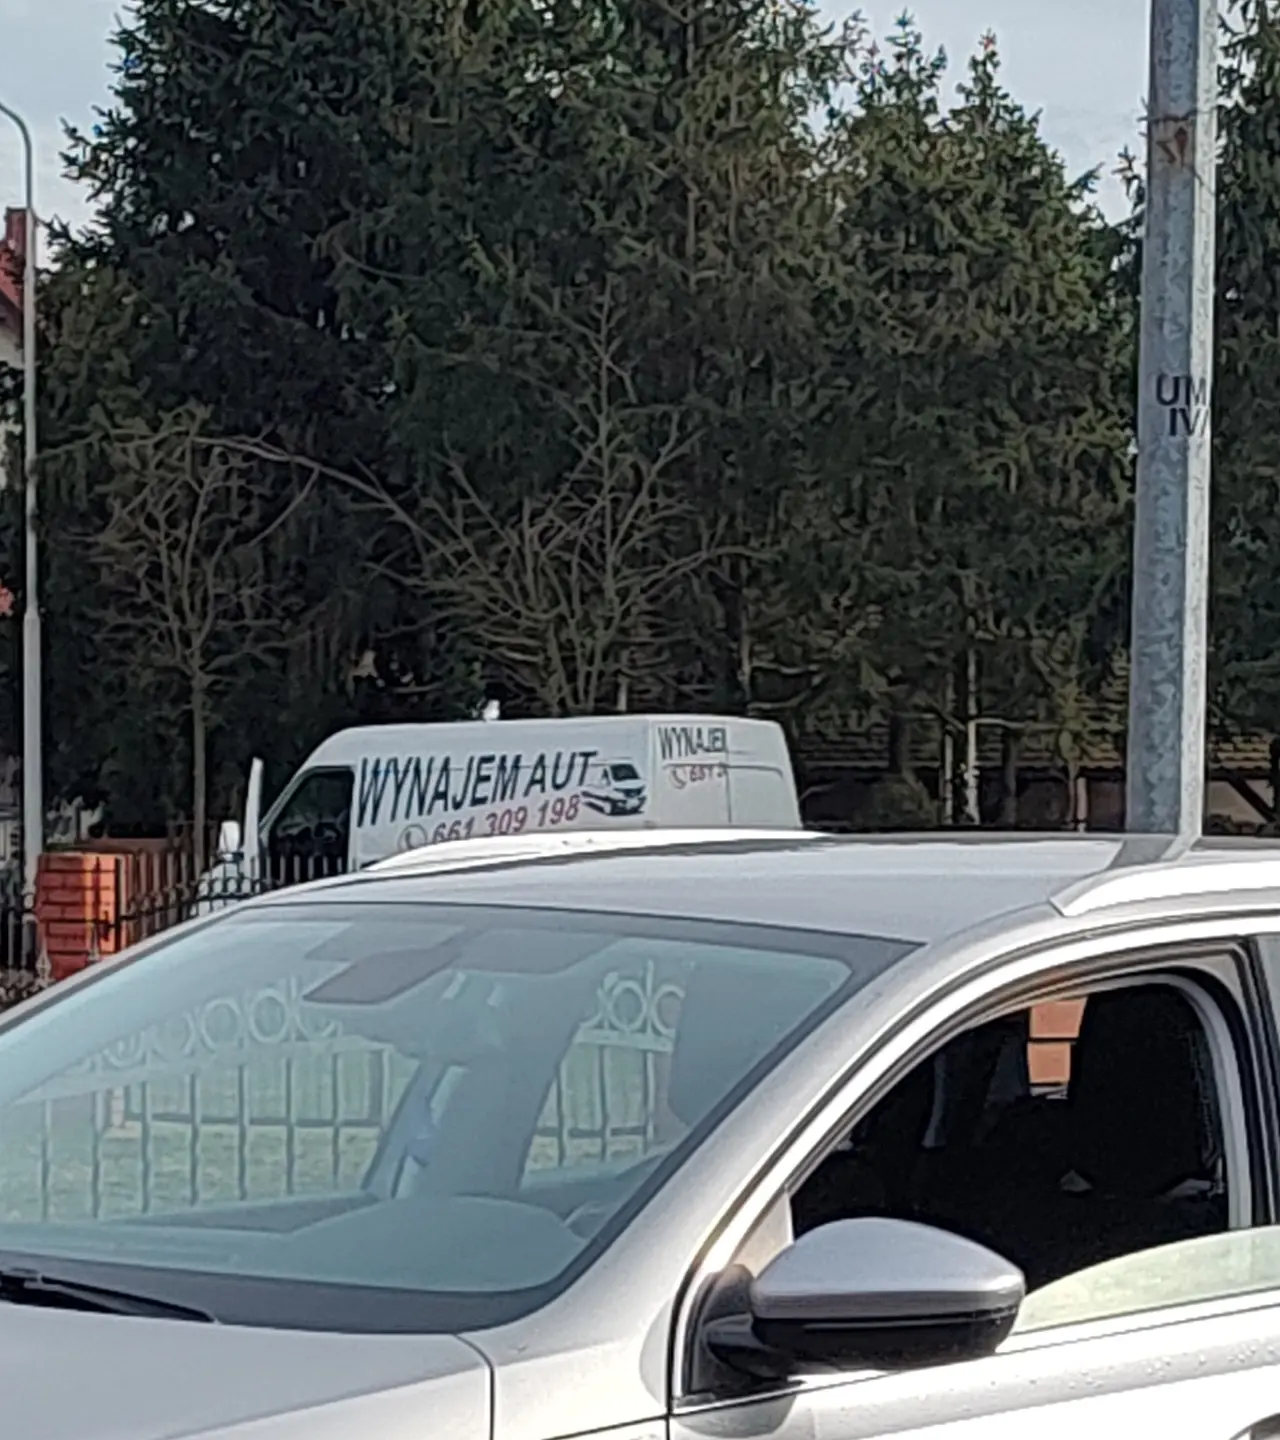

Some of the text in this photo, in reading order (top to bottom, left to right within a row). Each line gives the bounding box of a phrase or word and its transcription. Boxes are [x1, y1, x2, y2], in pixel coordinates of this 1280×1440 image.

[356, 753, 523, 829] WYNAJEM
[431, 793, 582, 844] 661 309 198
